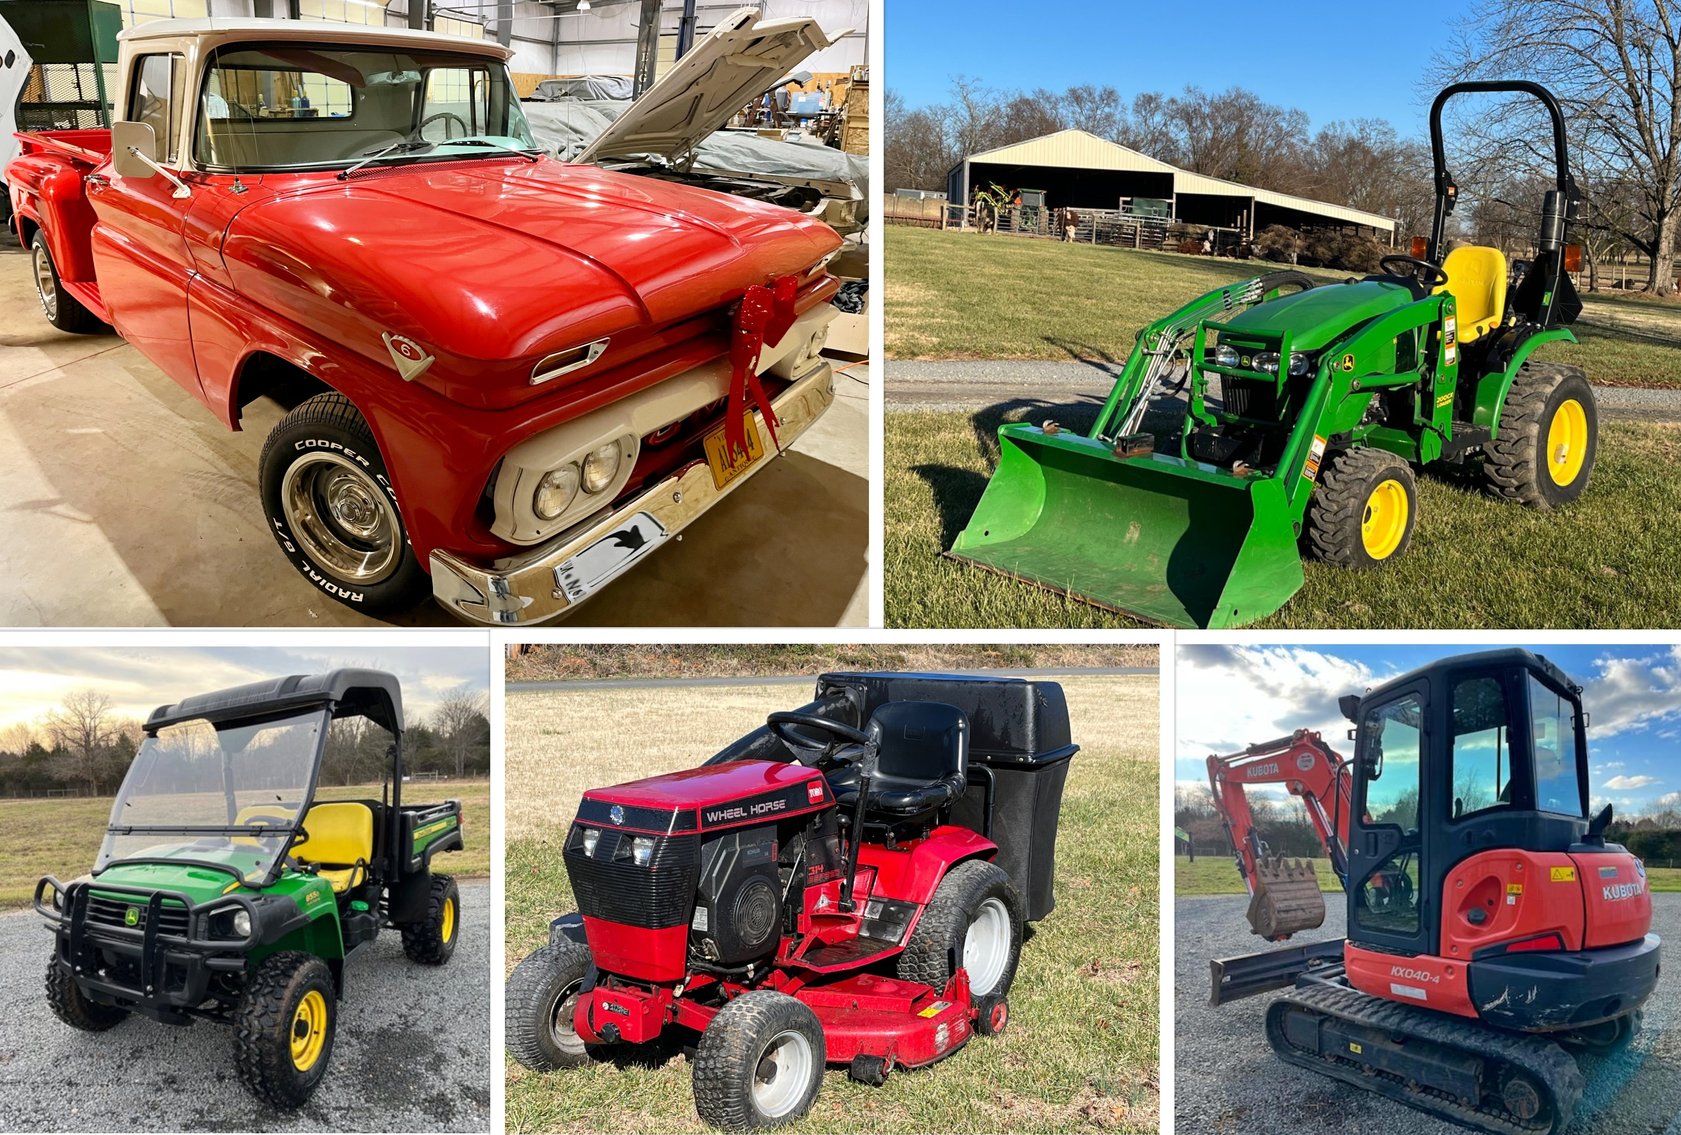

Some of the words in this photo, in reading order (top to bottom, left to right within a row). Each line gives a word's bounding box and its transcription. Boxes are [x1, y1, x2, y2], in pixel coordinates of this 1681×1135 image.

[400, 343, 411, 357] 6
[294, 438, 371, 468] COOPER
[301, 559, 365, 602] RADIAL
[1247, 762, 1279, 778] KUBOTA
[706, 807, 748, 822] WHEEL
[750, 799, 787, 815] HORSE
[1602, 883, 1643, 900] KUBOTA
